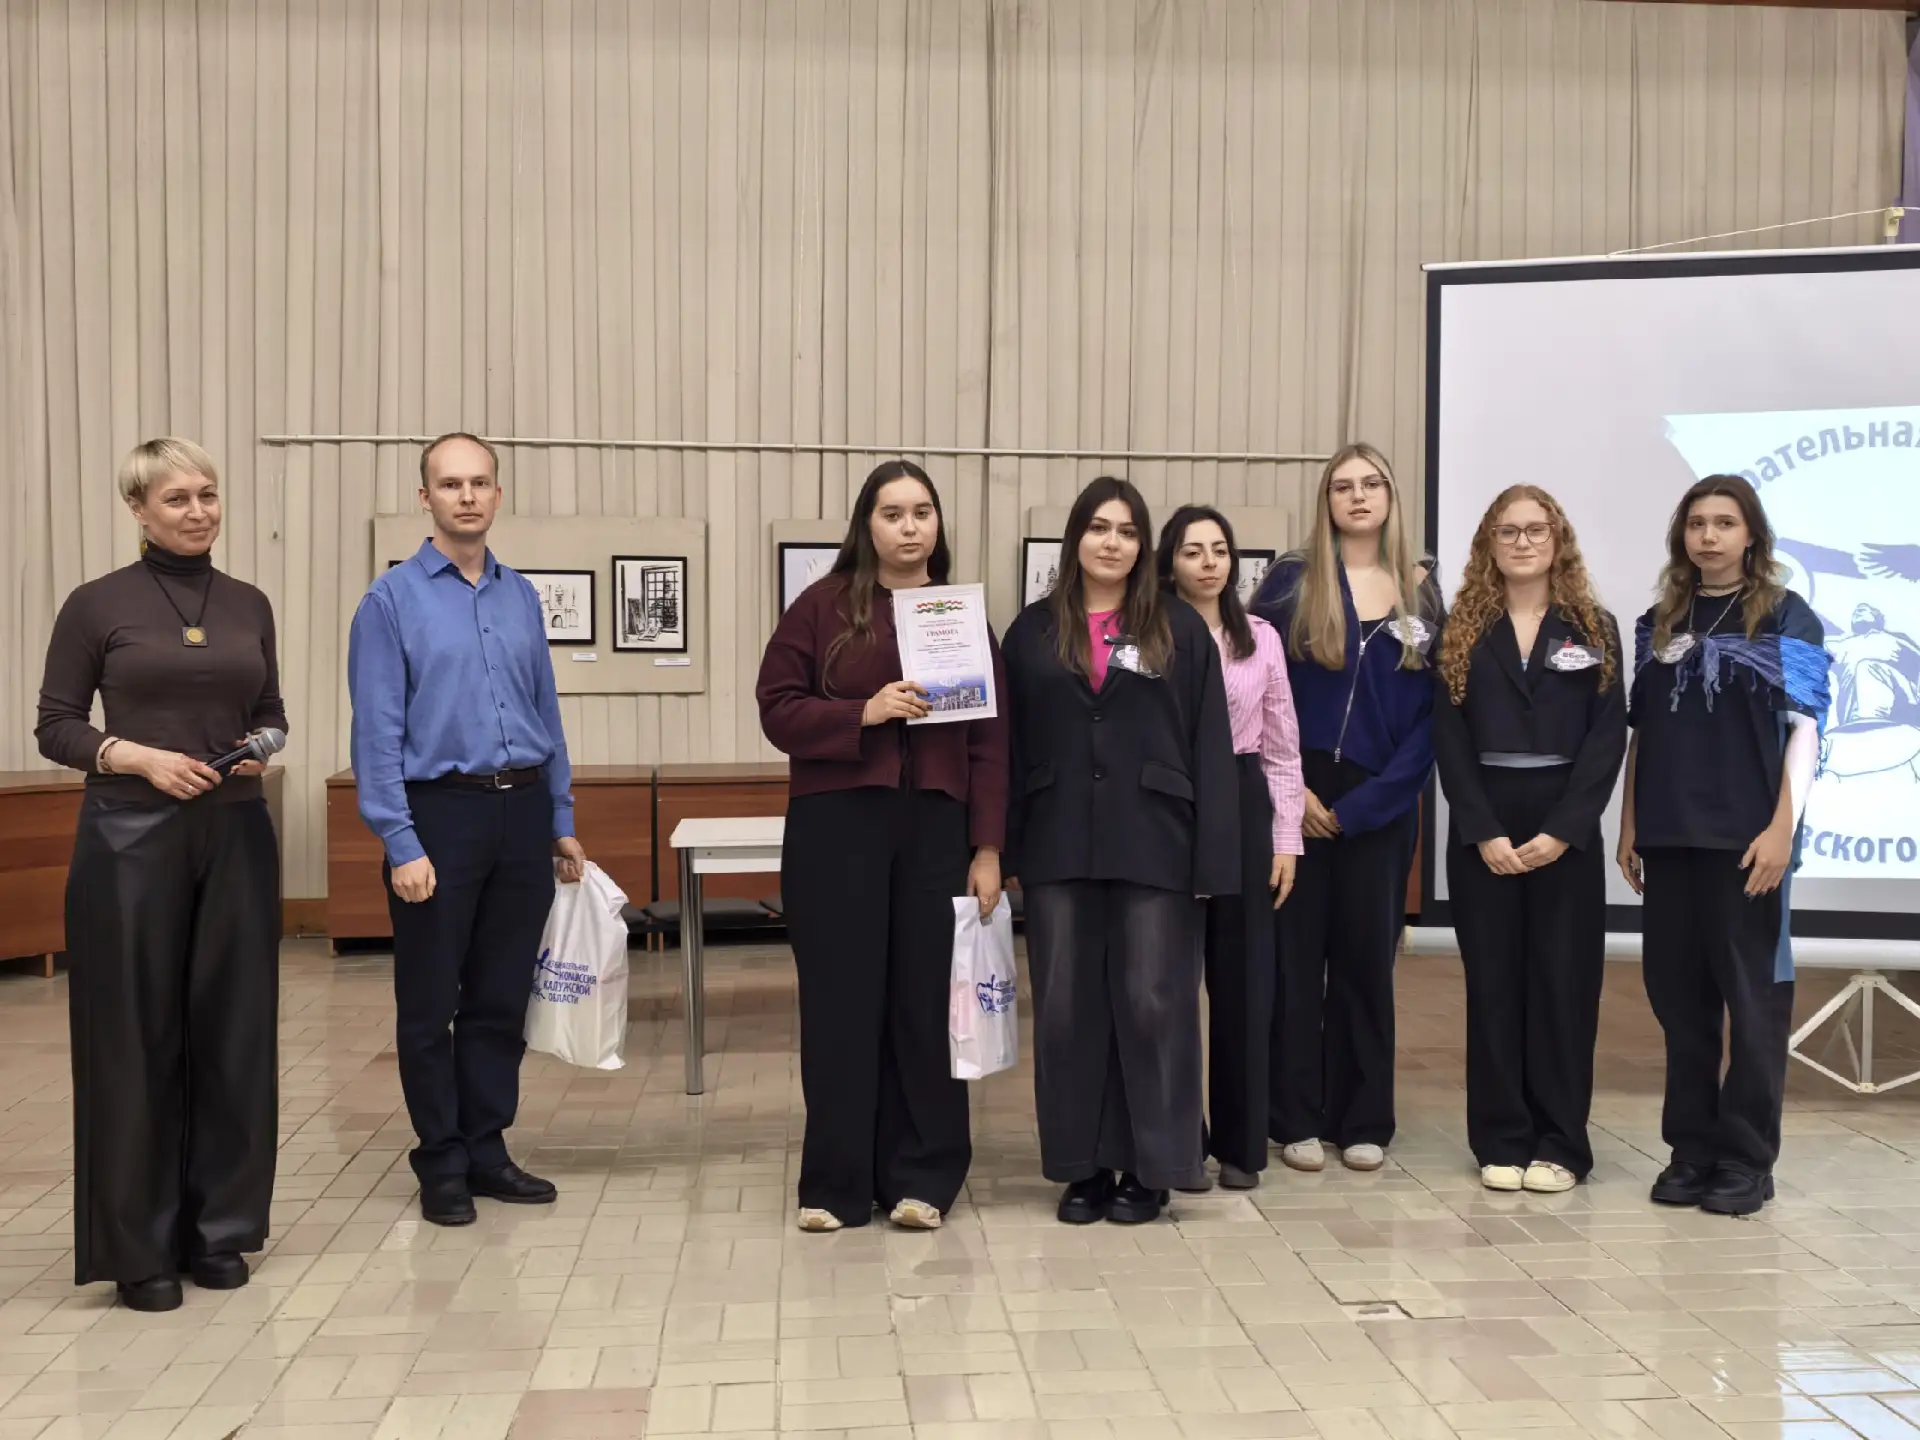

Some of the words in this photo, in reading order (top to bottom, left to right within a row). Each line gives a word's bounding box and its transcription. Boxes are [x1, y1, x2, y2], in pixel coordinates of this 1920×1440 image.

[1738, 419, 1920, 493] ательна
[543, 980, 590, 996] КАЛУЖСКОЙ
[548, 992, 579, 1005] ОБЛАСТИ
